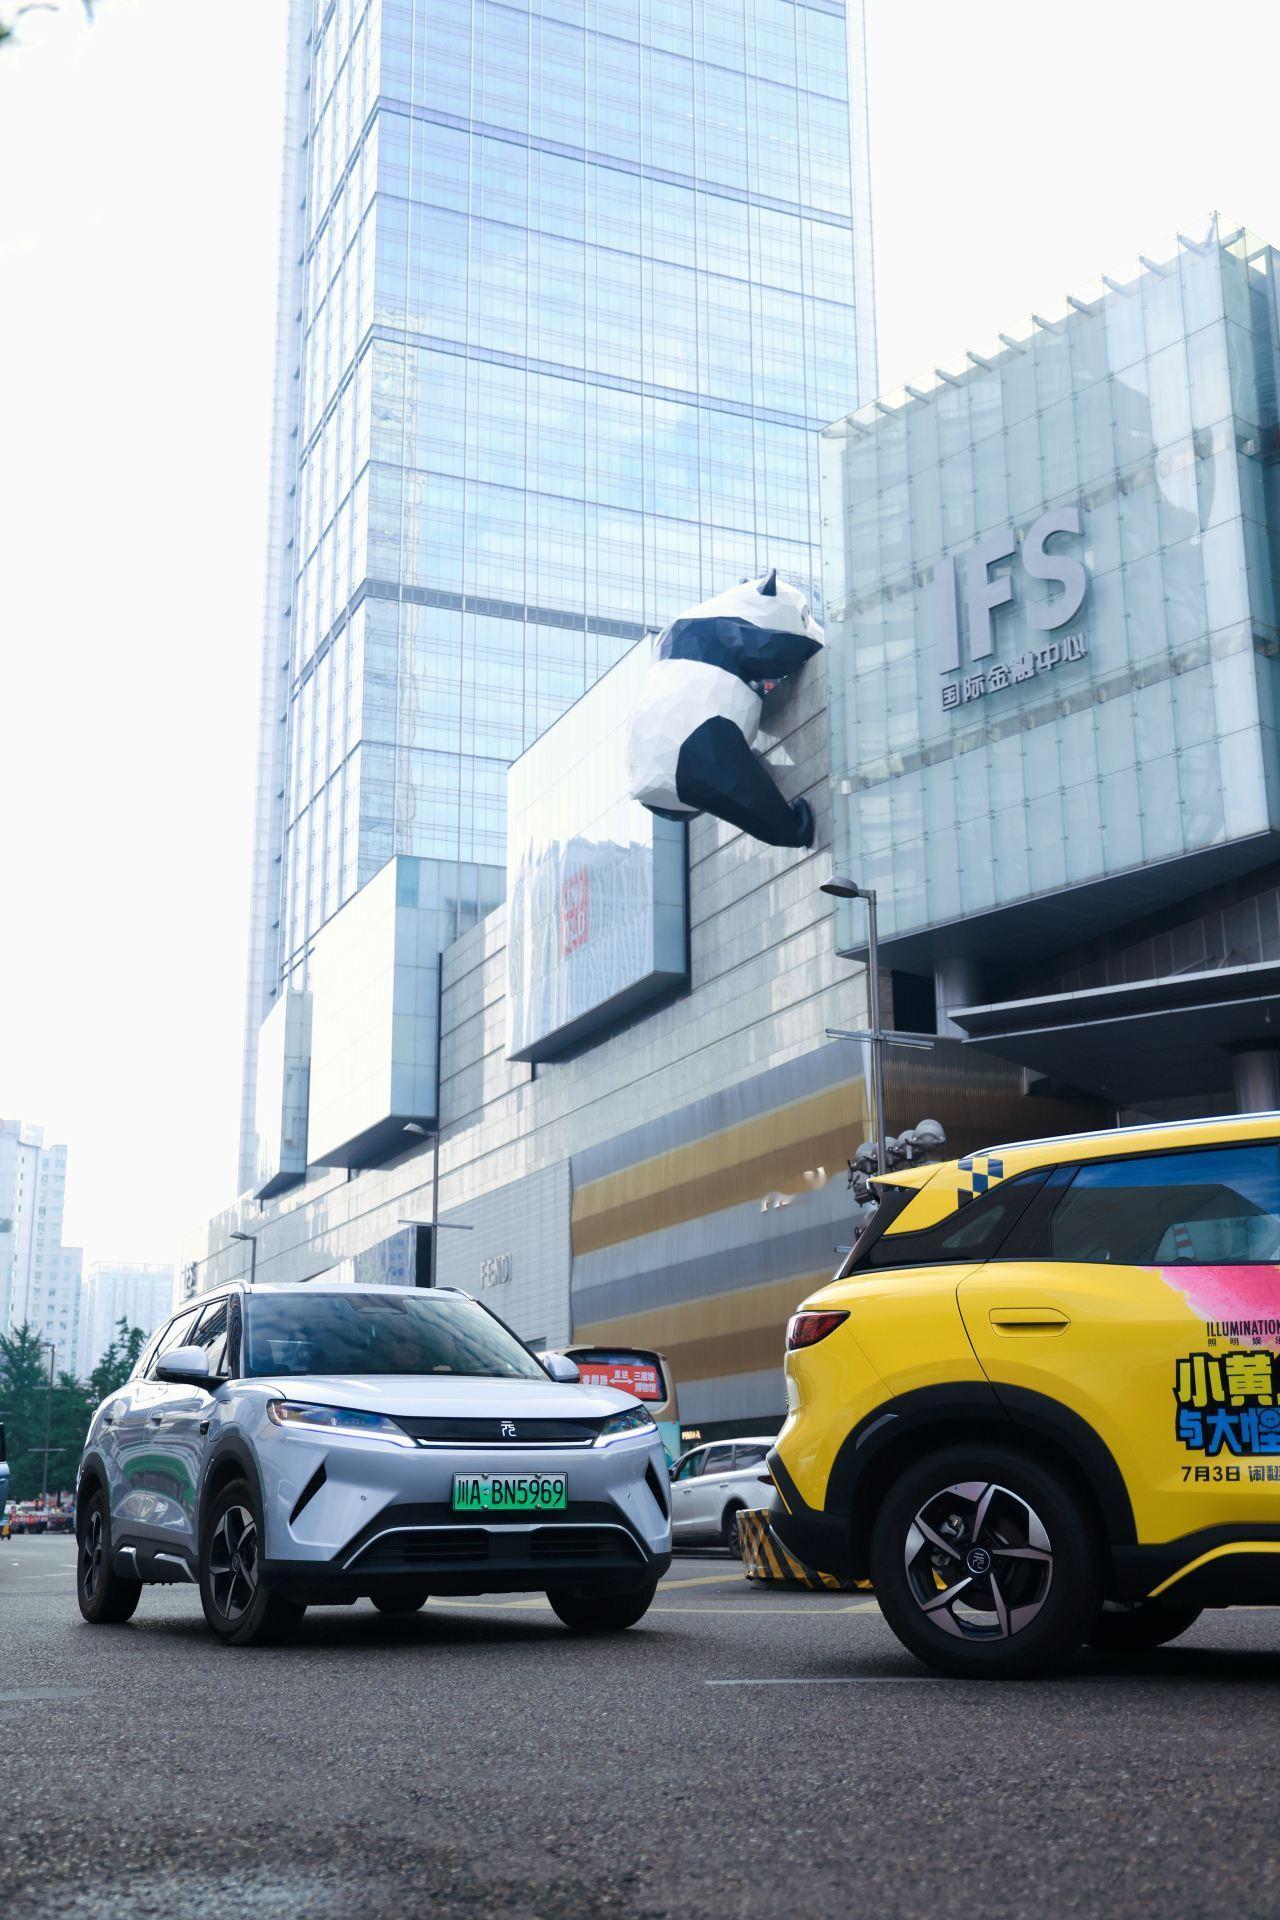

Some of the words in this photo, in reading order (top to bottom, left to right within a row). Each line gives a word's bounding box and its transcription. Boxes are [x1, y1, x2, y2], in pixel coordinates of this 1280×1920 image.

[934, 507, 1086, 675] IFS
[942, 633, 1088, 712] 国际金融中心
[480, 1252, 512, 1290] FENDI
[1176, 1352, 1280, 1408] 小黄
[1181, 1466, 1241, 1482] 7月3日
